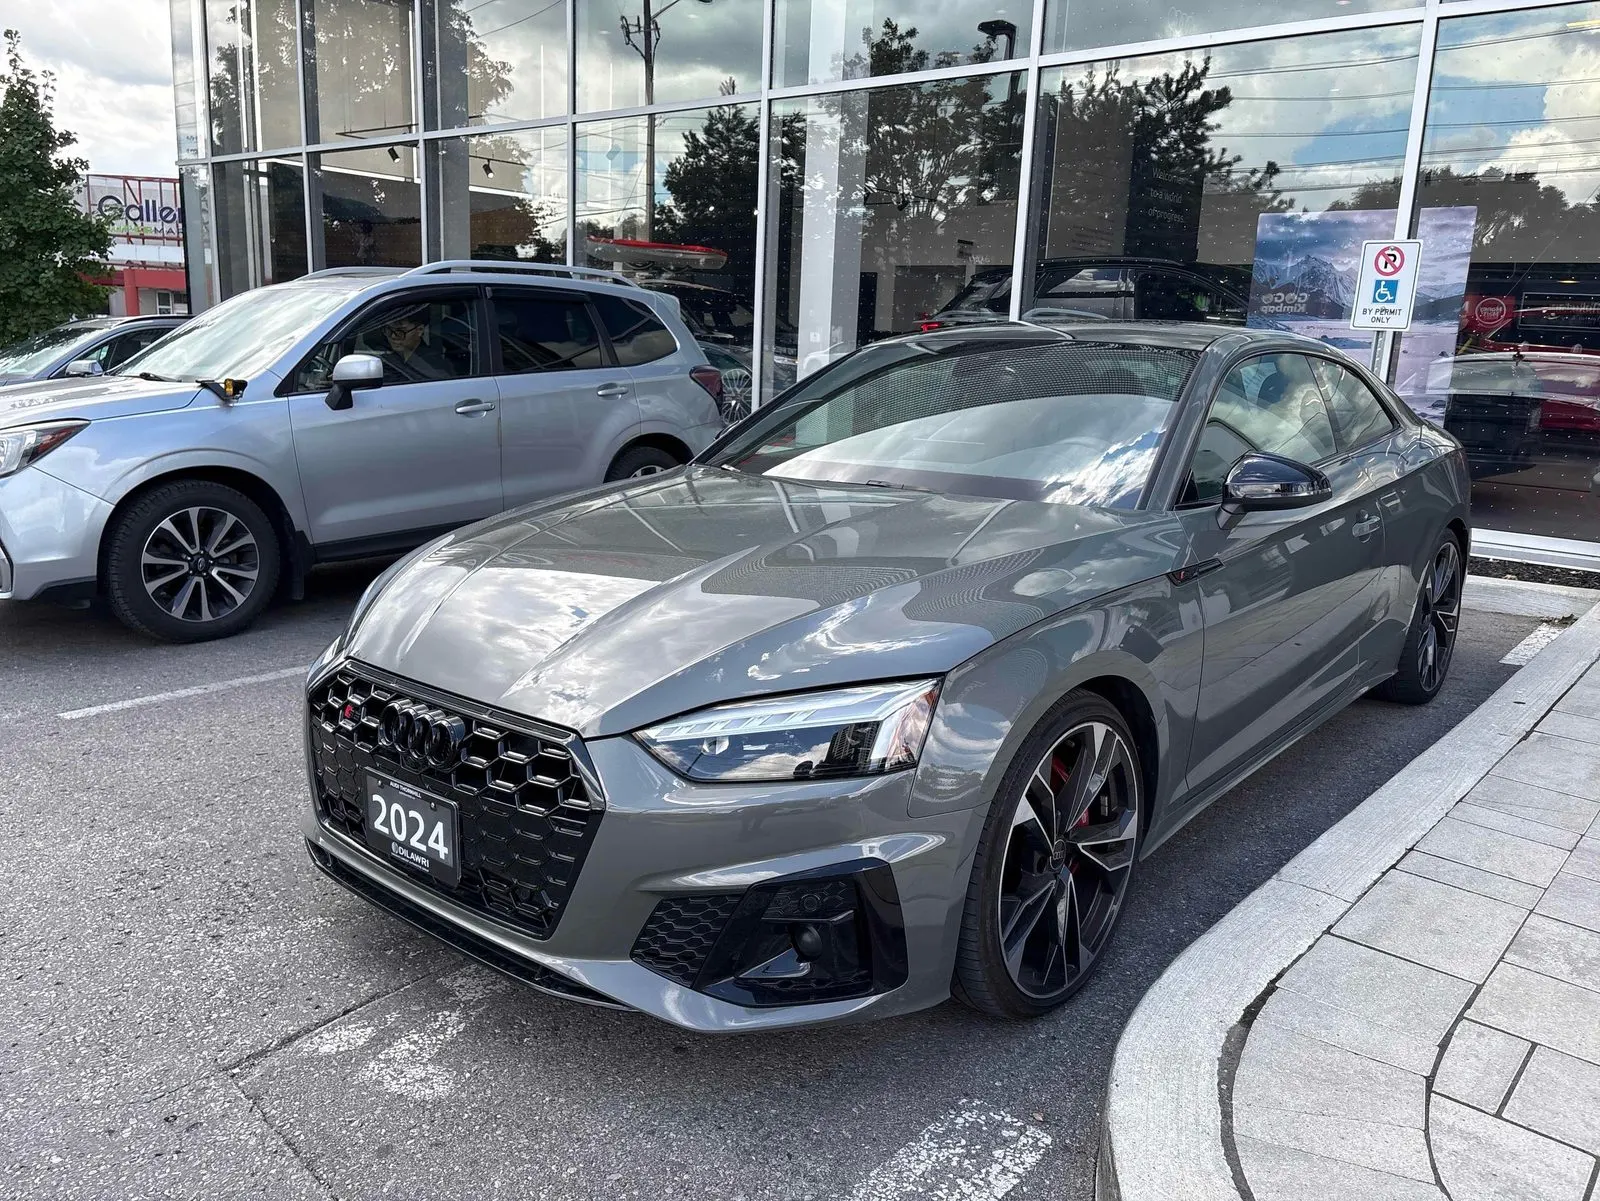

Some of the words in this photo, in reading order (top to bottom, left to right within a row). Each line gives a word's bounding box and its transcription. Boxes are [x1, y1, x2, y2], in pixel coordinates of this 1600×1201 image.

[1164, 192, 1183, 204] world
[1374, 308, 1402, 316] PERMIT
[1370, 316, 1391, 324] ONLY
[372, 793, 449, 860] 2024
[398, 846, 430, 868] DILAWRI
